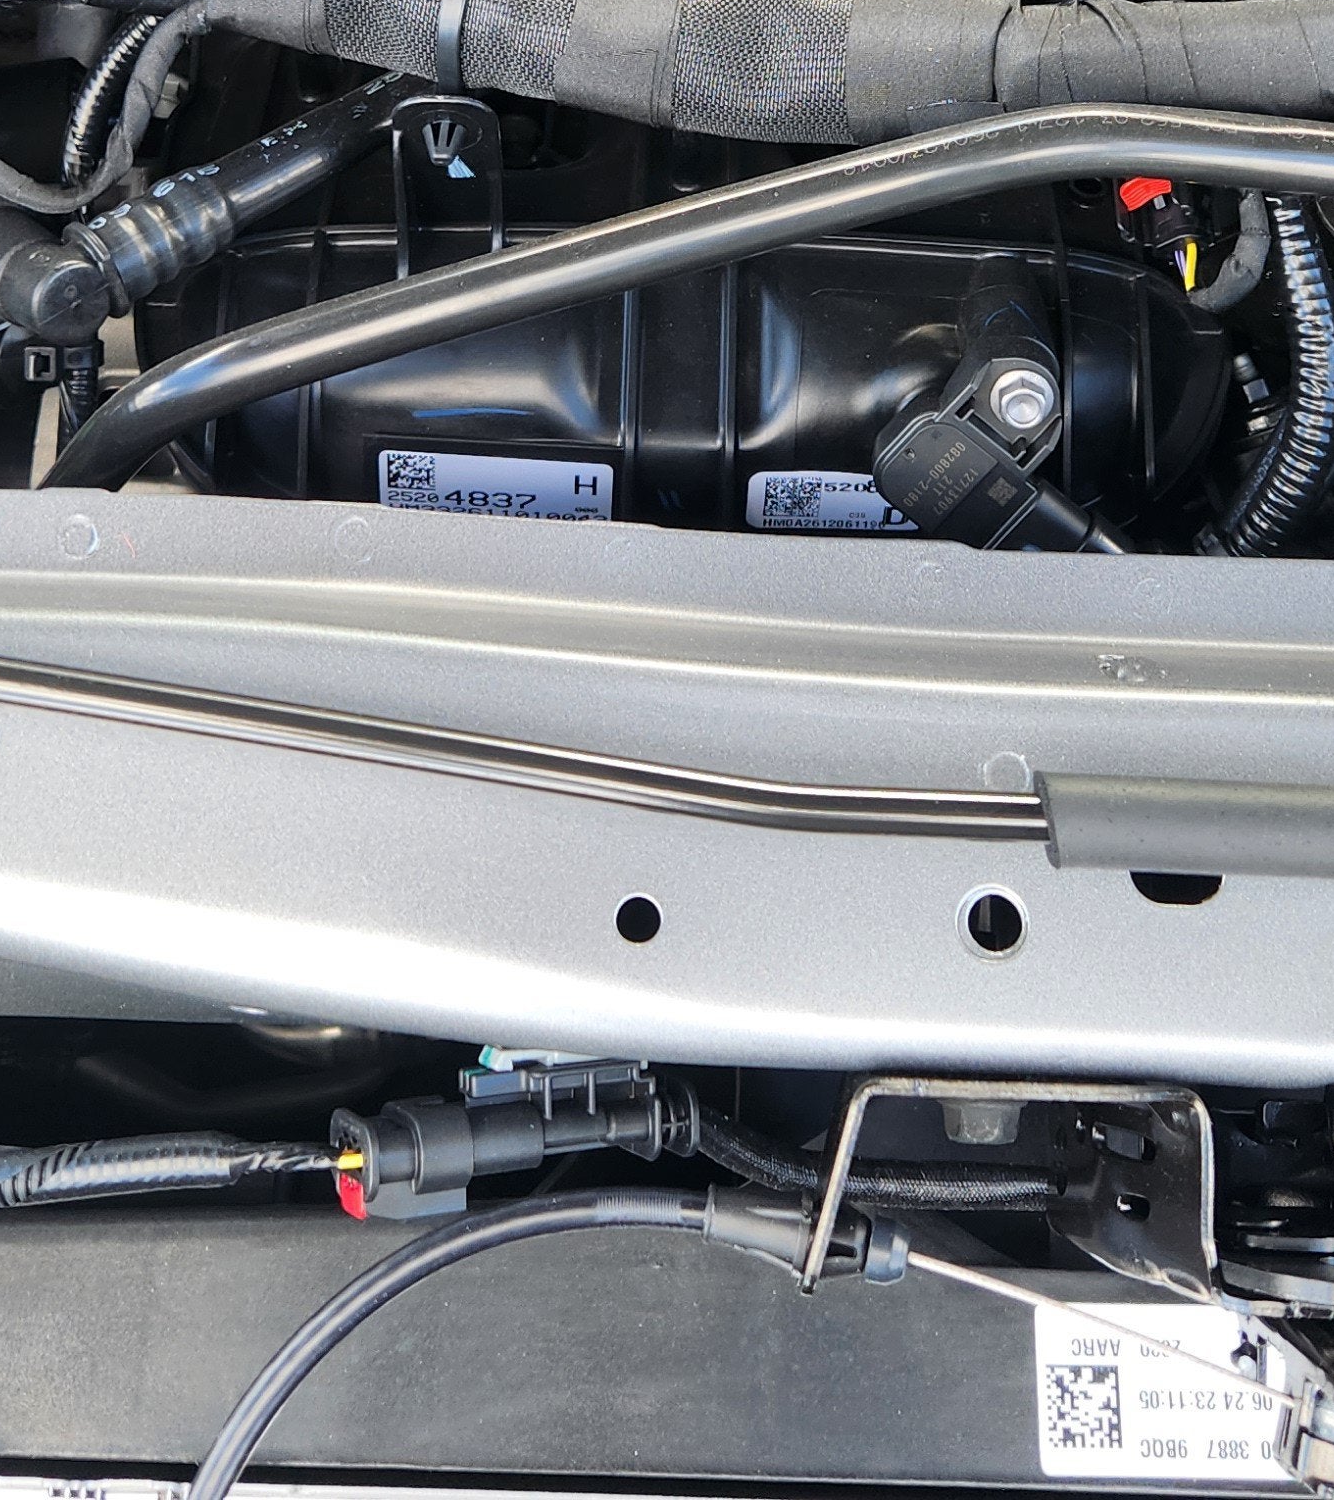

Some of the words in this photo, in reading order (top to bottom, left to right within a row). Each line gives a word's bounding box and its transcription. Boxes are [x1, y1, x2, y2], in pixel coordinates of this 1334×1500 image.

[573, 474, 599, 497] H
[387, 489, 439, 504] 2520
[443, 489, 538, 510] 4837
[1071, 1337, 1121, 1357] AARC
[1138, 1389, 1217, 1411] 23:11:05
[1139, 1438, 1188, 1459] 9BQC
[1207, 1438, 1250, 1460] 3887
